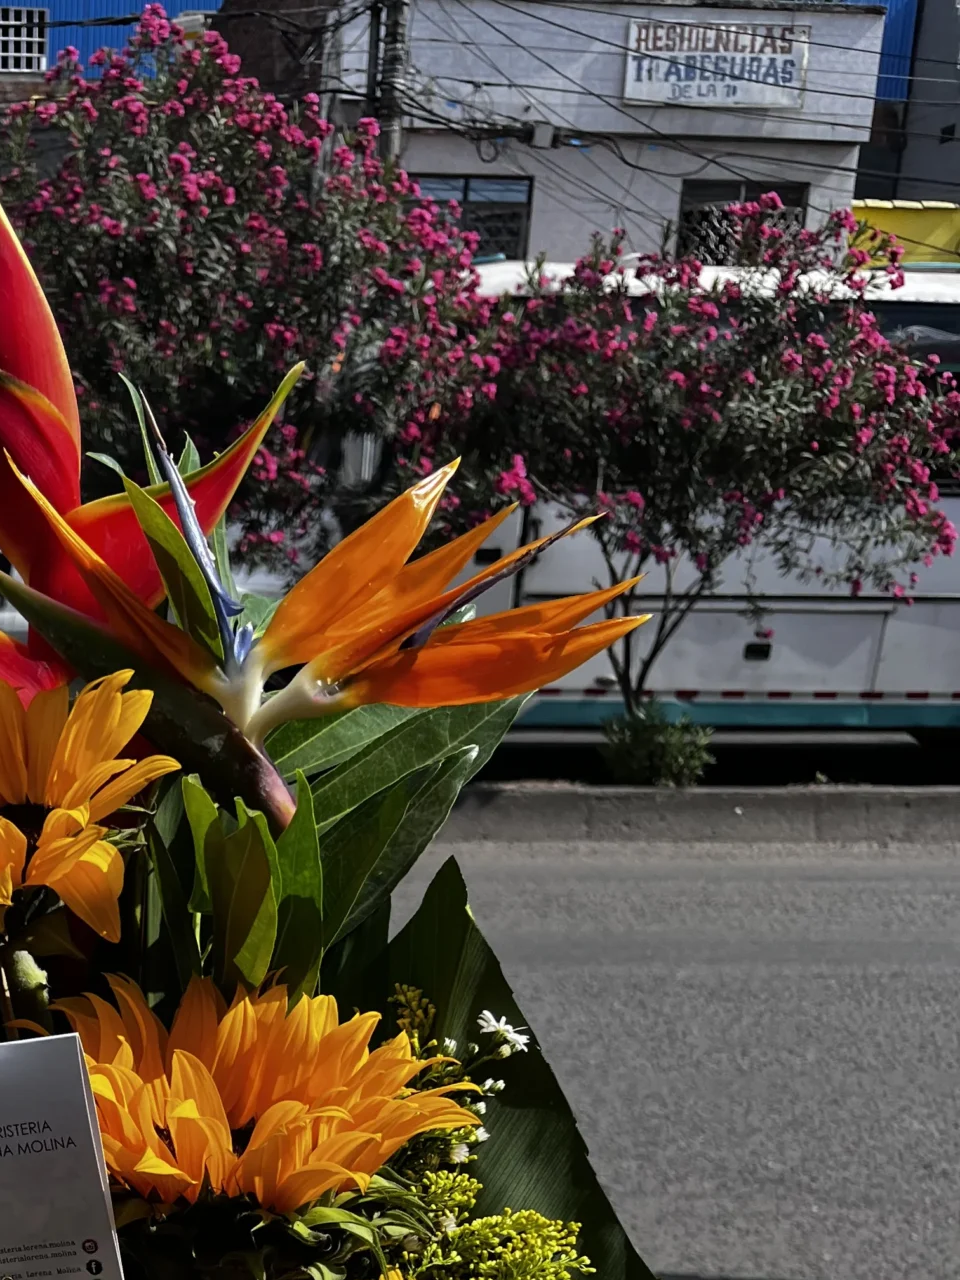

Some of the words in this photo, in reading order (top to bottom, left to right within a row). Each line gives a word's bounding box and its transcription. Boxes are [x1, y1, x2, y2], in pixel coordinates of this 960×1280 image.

[668, 83, 692, 100] DE
[697, 84, 718, 97] LA
[17, 1136, 77, 1155] MOLINA
